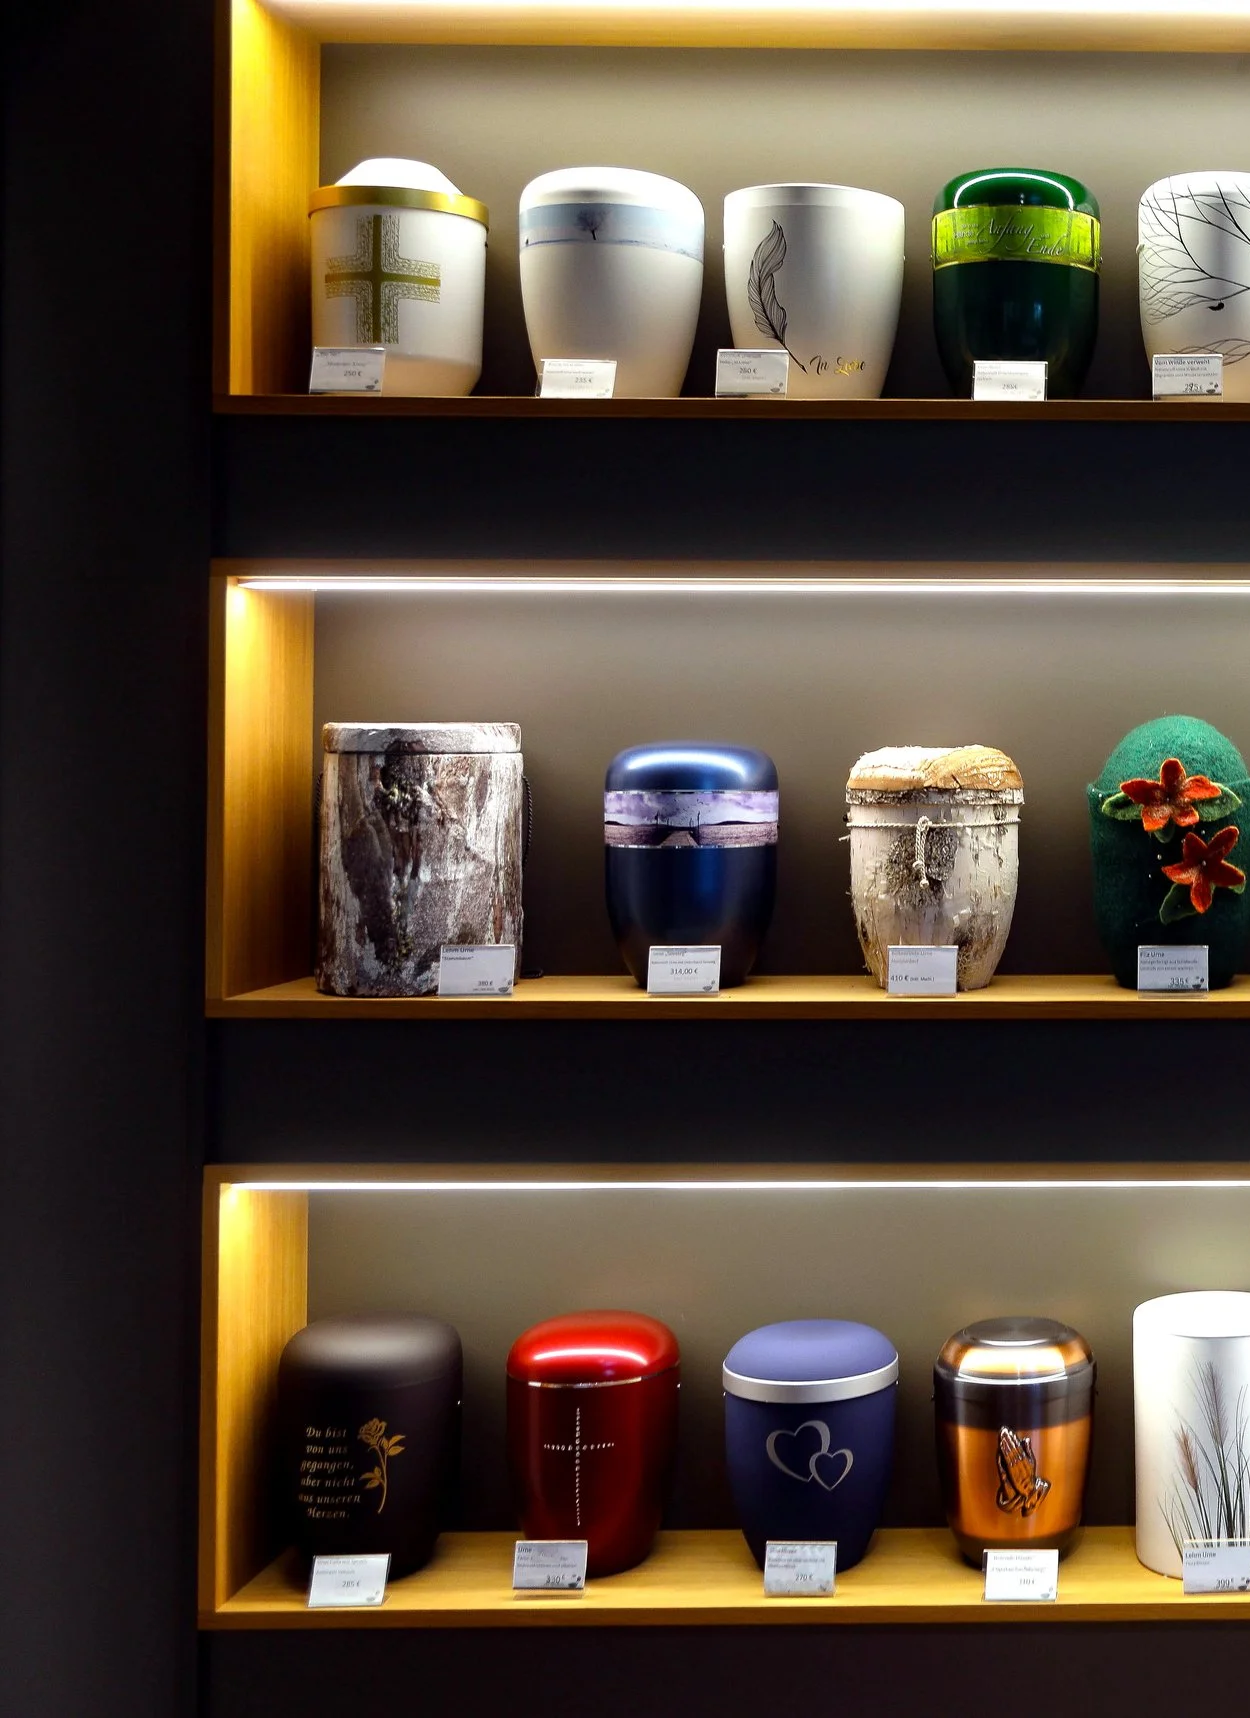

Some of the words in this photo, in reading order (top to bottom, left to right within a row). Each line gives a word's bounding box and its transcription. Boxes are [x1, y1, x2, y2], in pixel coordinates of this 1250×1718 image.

[1026, 233, 1068, 256] Ende
[306, 1426, 322, 1438] Du
[325, 1427, 347, 1438] bist
[306, 1445, 324, 1454] von
[328, 1446, 348, 1454] uns
[301, 1475, 321, 1487] aber
[325, 1477, 355, 1487] nicht
[299, 1494, 313, 1503] aus
[317, 1495, 360, 1503] unseren
